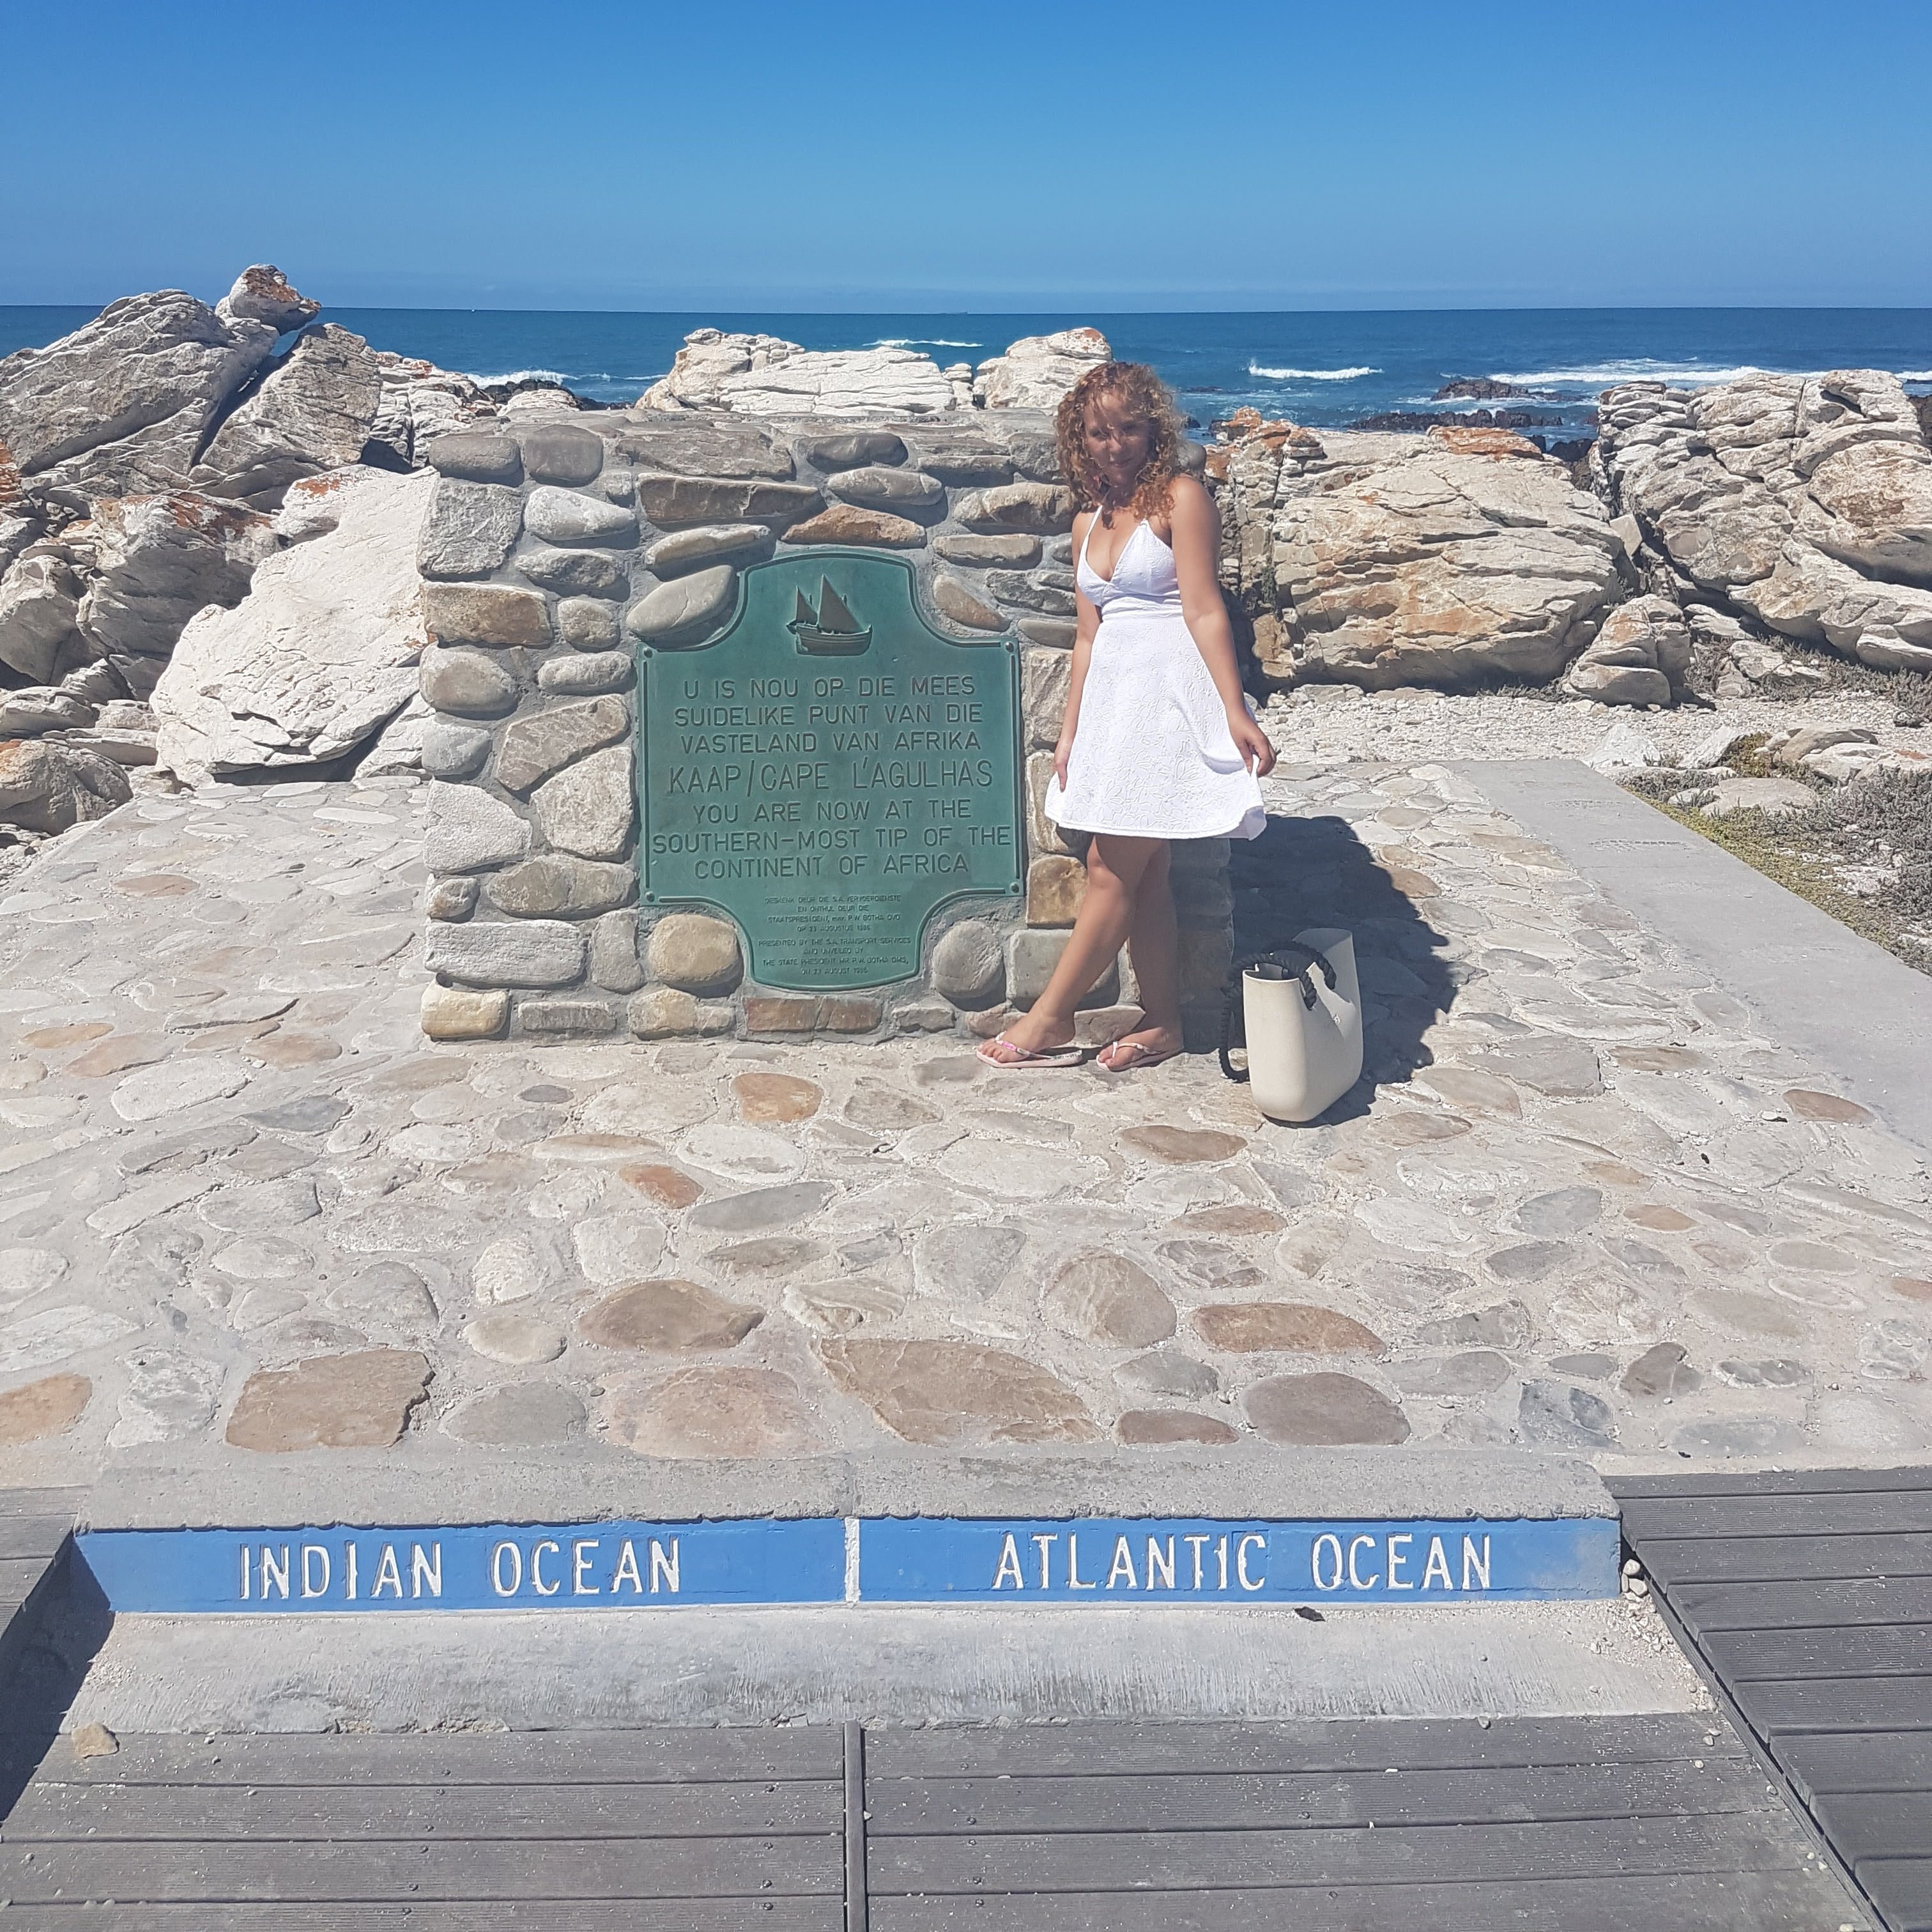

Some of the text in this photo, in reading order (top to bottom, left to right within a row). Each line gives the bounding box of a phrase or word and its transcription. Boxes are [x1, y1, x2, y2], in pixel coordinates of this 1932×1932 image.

[684, 676, 976, 698] U IS NOU OP DIE MEES
[675, 703, 983, 727] SUIDELIKE PUNT VAN DIE
[680, 731, 981, 754] VASTELAND VAN AFRIKA
[670, 756, 993, 797] KAAP/CAPE L'AGULHAS
[693, 799, 972, 824] YOU ARE NOW AT THE
[652, 825, 1011, 854] SOUTHERN-MOST TIP OF THE
[695, 854, 969, 880] CONTINENT OF AFRICA
[240, 1537, 679, 1599] INDIAN OCEAN
[992, 1532, 1491, 1591] ATLANTIC OCEAN
